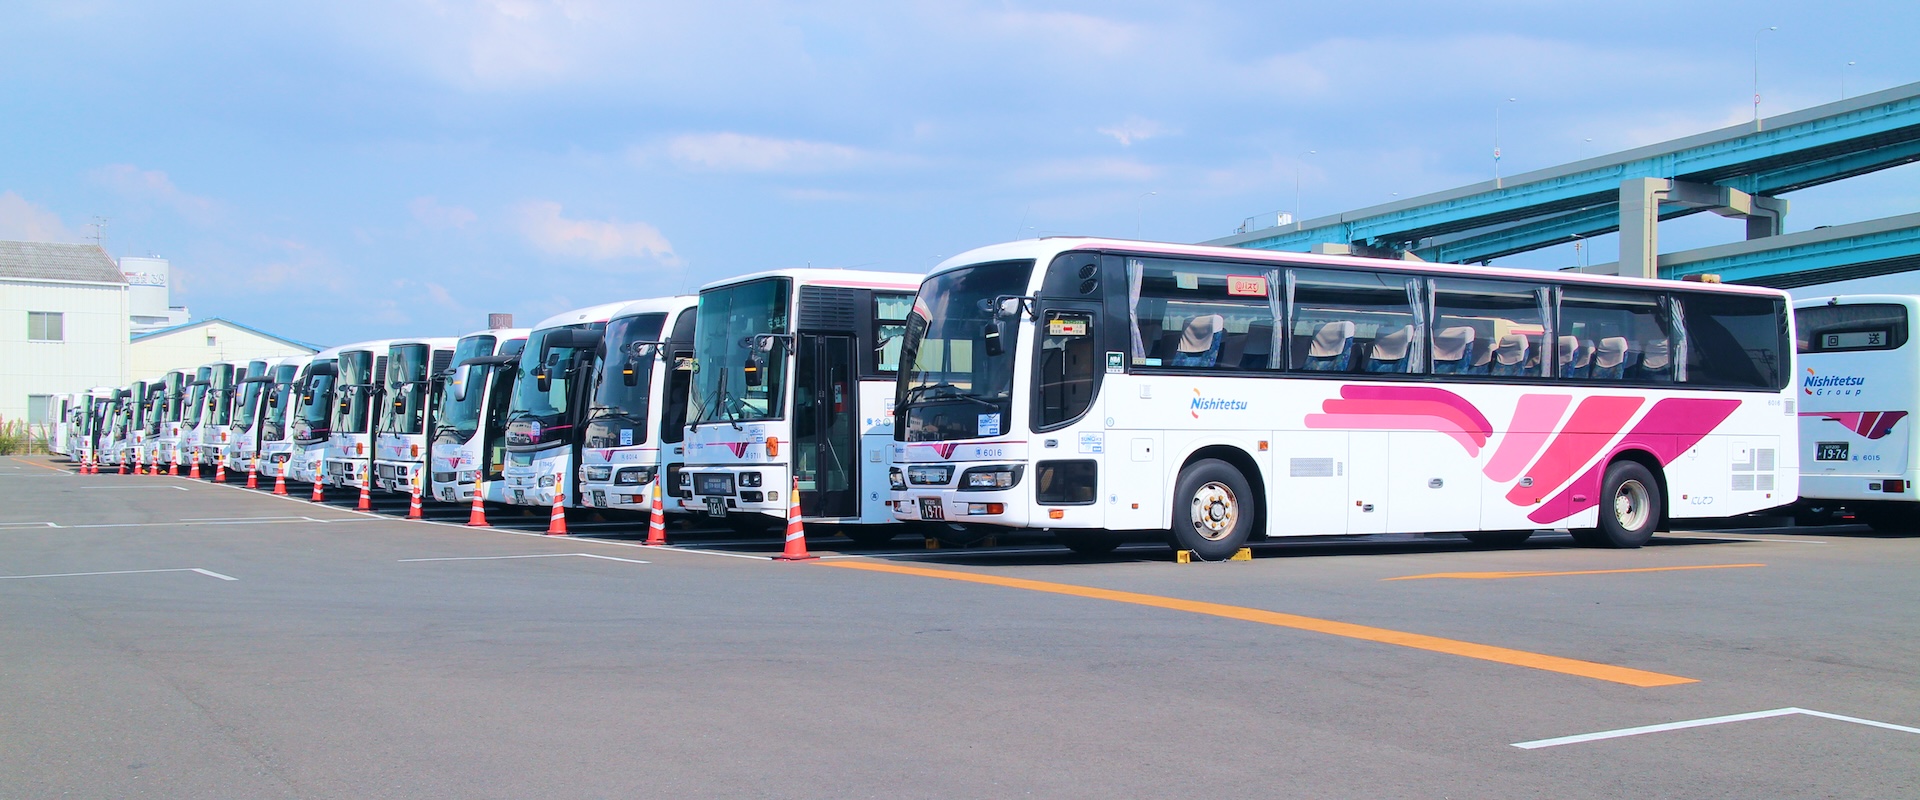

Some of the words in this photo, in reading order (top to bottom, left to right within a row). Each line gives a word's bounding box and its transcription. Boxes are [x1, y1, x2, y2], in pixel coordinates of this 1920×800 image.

[150, 273, 166, 285] 39
[1803, 375, 1865, 388] Nishitetsu
[1816, 388, 1862, 397] Group
[1190, 397, 1248, 411] Nishitetsu
[983, 448, 1003, 457] 6016
[1822, 448, 1848, 460] 19-76
[924, 505, 943, 519] 19-77
